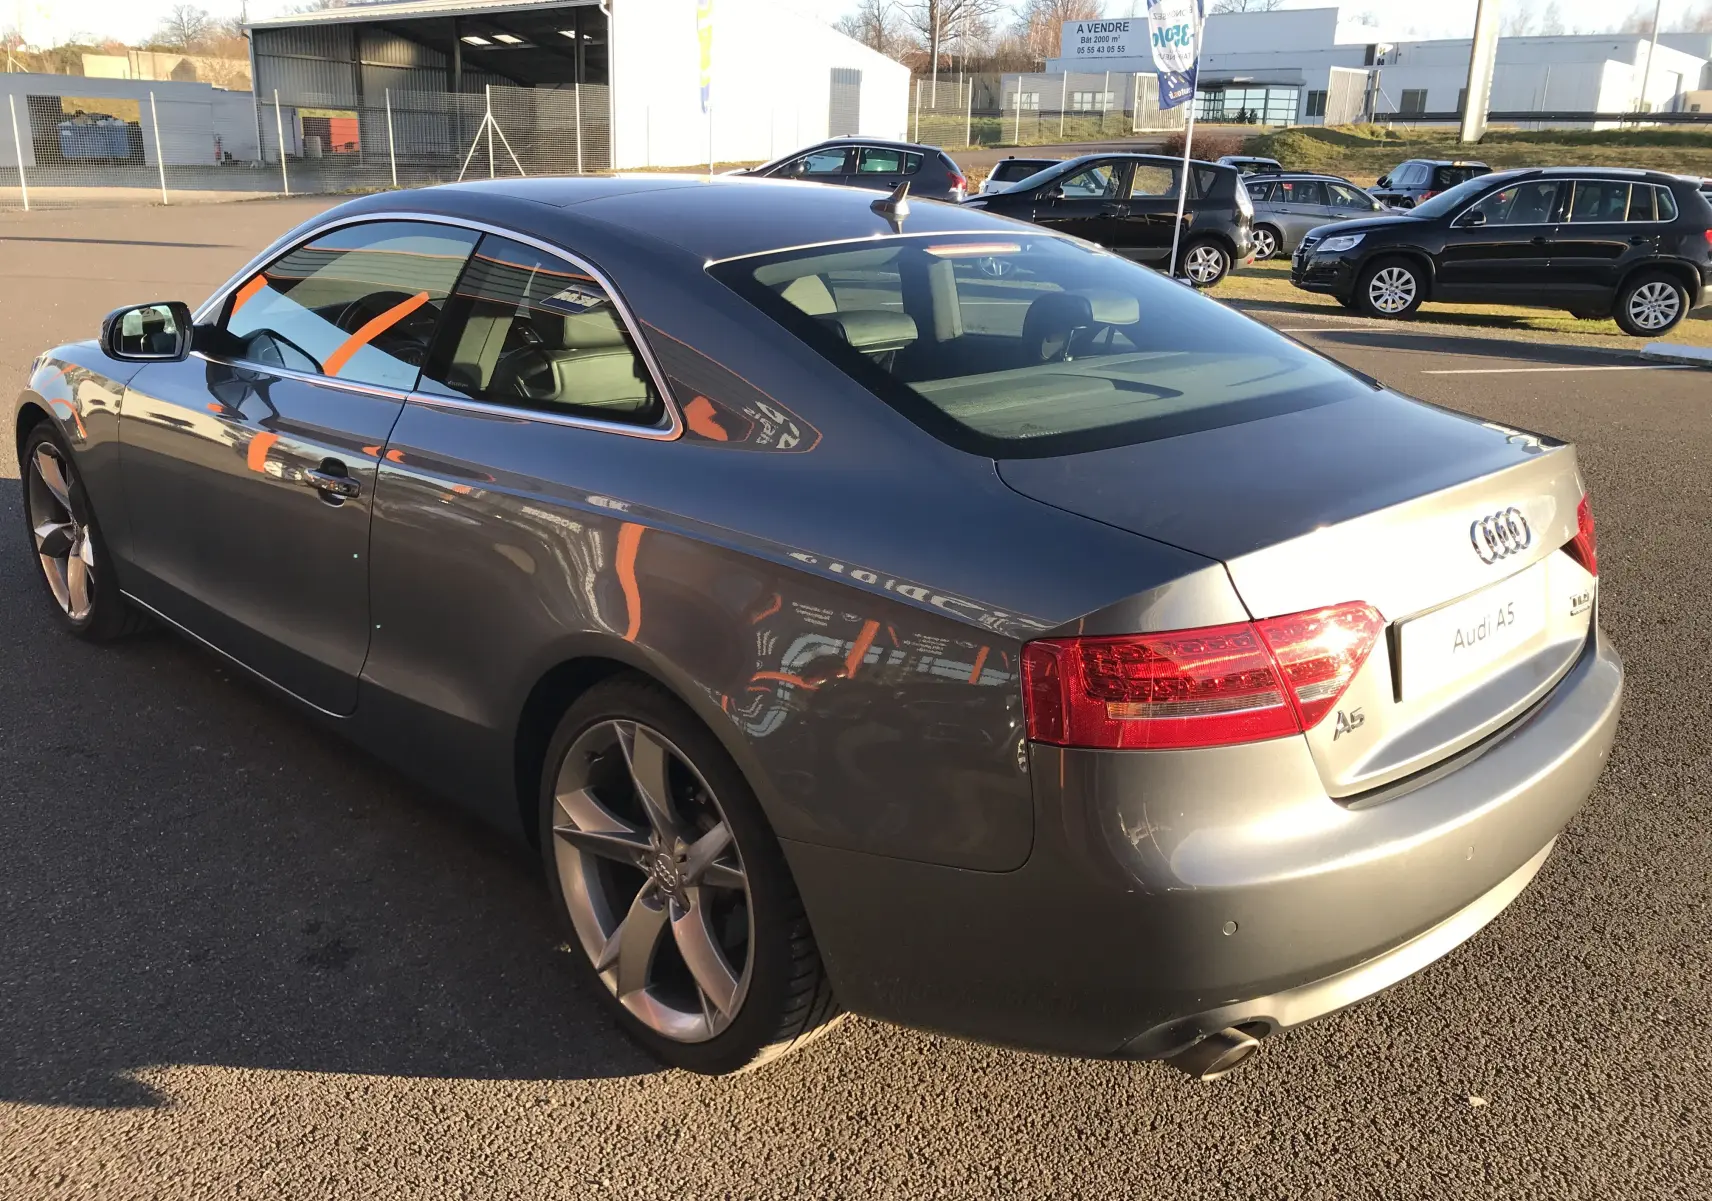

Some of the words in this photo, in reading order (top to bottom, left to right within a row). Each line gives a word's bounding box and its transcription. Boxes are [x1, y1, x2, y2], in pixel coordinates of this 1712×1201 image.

[1077, 23, 1084, 34] A
[1087, 21, 1130, 33] VENDRE
[1080, 36, 1092, 44] Bât
[1093, 35, 1110, 44] 2000
[1077, 46, 1085, 54] 05
[1107, 45, 1115, 53] 05
[1117, 45, 1125, 53] 55
[1453, 614, 1491, 654] Audi
[1497, 602, 1515, 631] A5
[1333, 707, 1365, 741] A5
